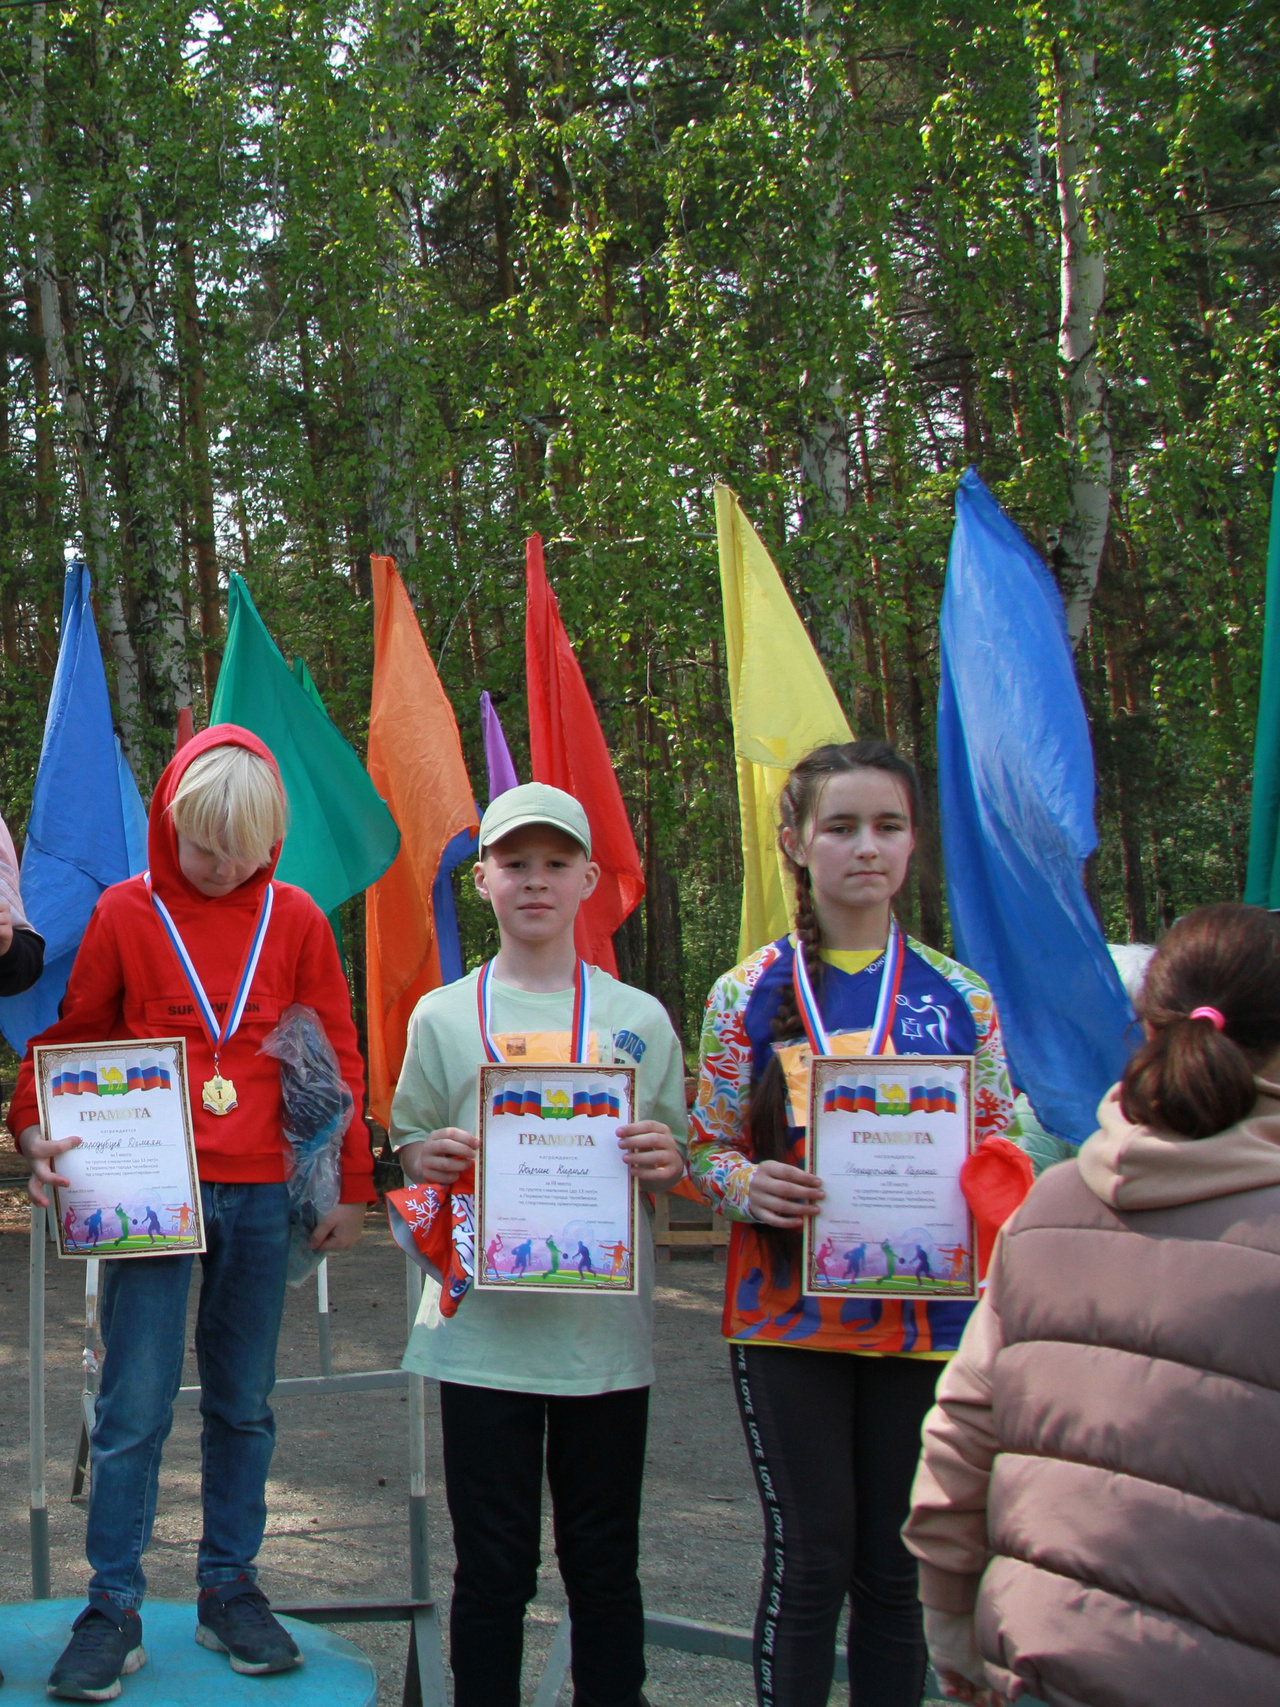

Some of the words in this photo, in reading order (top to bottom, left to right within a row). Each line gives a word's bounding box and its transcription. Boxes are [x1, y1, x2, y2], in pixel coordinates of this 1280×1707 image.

[216, 1090, 222, 1099] 1
[79, 1107, 151, 1121] ГРАМОТА
[519, 1133, 595, 1147] ГРАМОТА
[852, 1131, 933, 1145] ГРАМОТА
[740, 1379, 754, 1415] LOVE
[748, 1421, 765, 1459] LOVE
[759, 1466, 776, 1501] LOVE
[770, 1507, 784, 1543] LOVE
[773, 1547, 784, 1584] LOVE
[766, 1585, 782, 1617] LOVE
[761, 1620, 776, 1656] LOVE
[761, 1658, 773, 1694] LOVE
